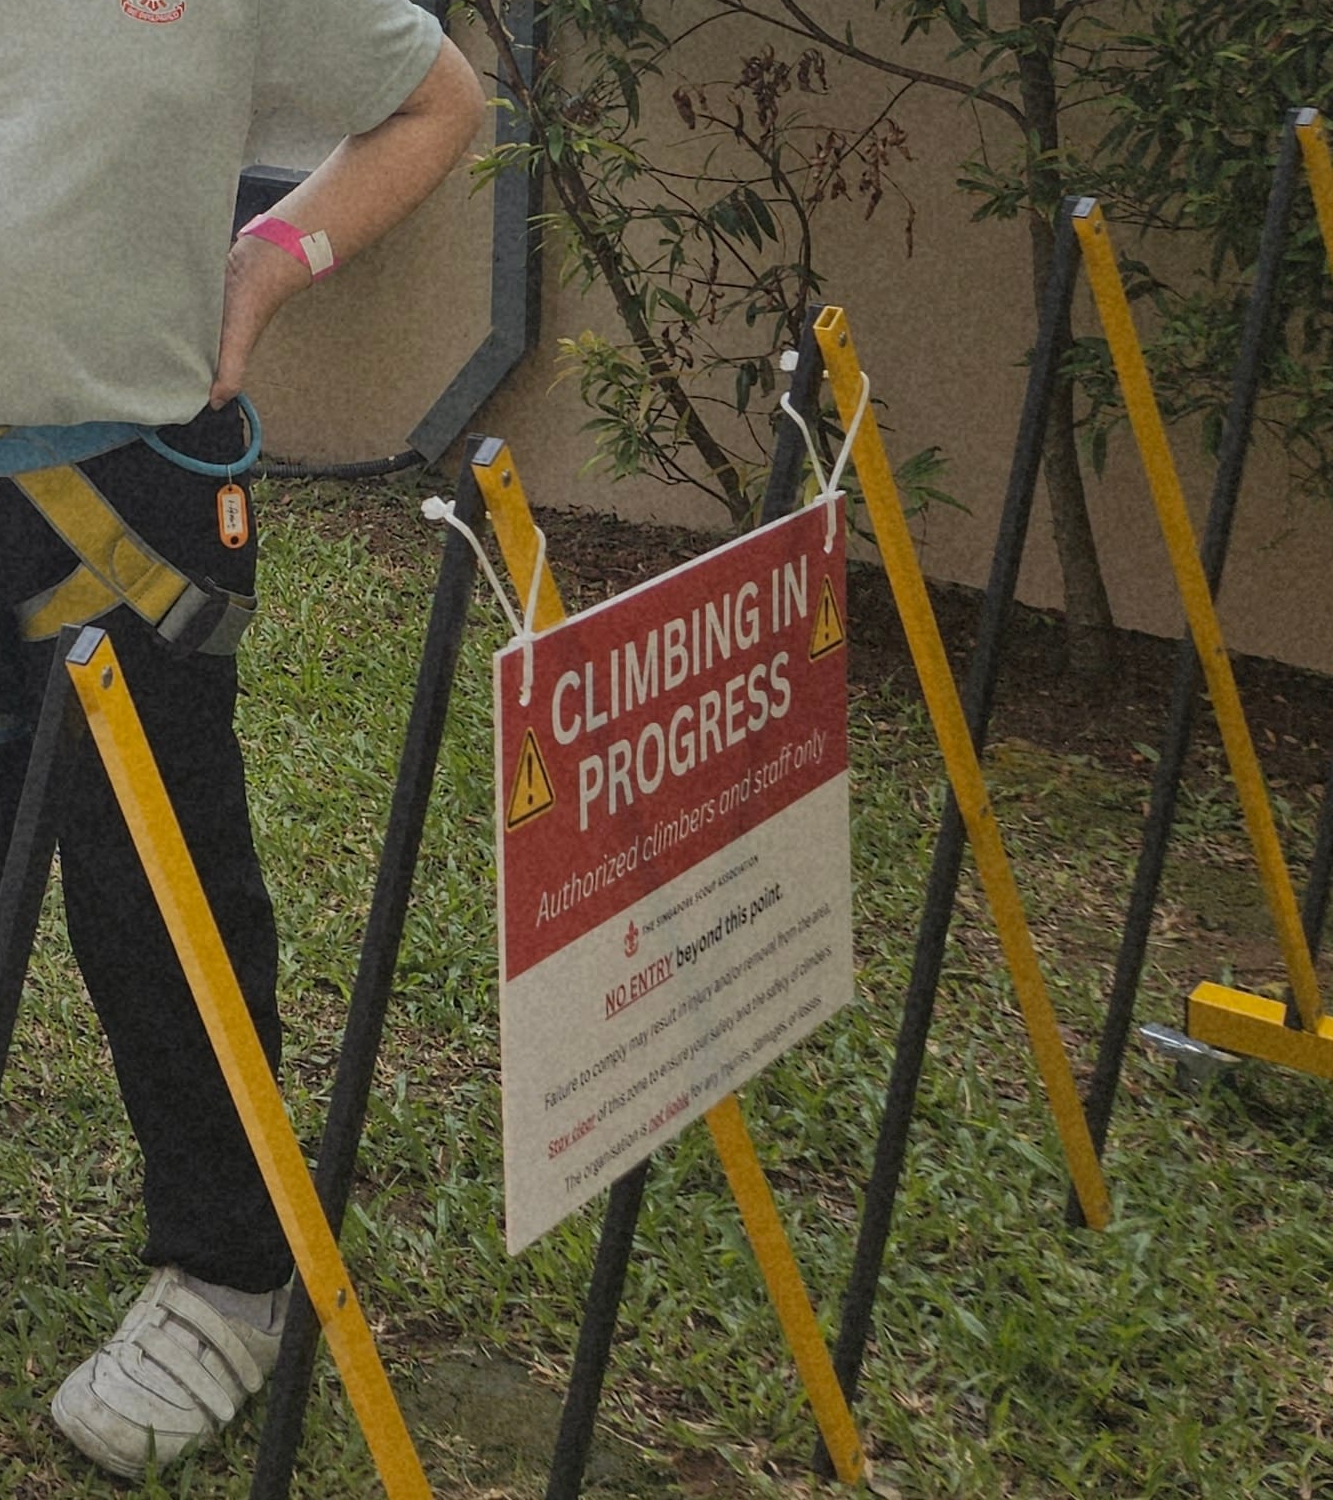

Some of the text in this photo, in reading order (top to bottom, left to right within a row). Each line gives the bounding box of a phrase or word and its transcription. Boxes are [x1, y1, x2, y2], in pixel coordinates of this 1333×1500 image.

[551, 554, 808, 746] CLIMBING IN
[579, 651, 792, 832] PROGRESS
[535, 728, 827, 928] Authorized climbers and staff only
[606, 984, 627, 1016] NO
[630, 952, 673, 1001] ENTRY
[676, 918, 722, 968] beyond
[725, 905, 747, 935] this
